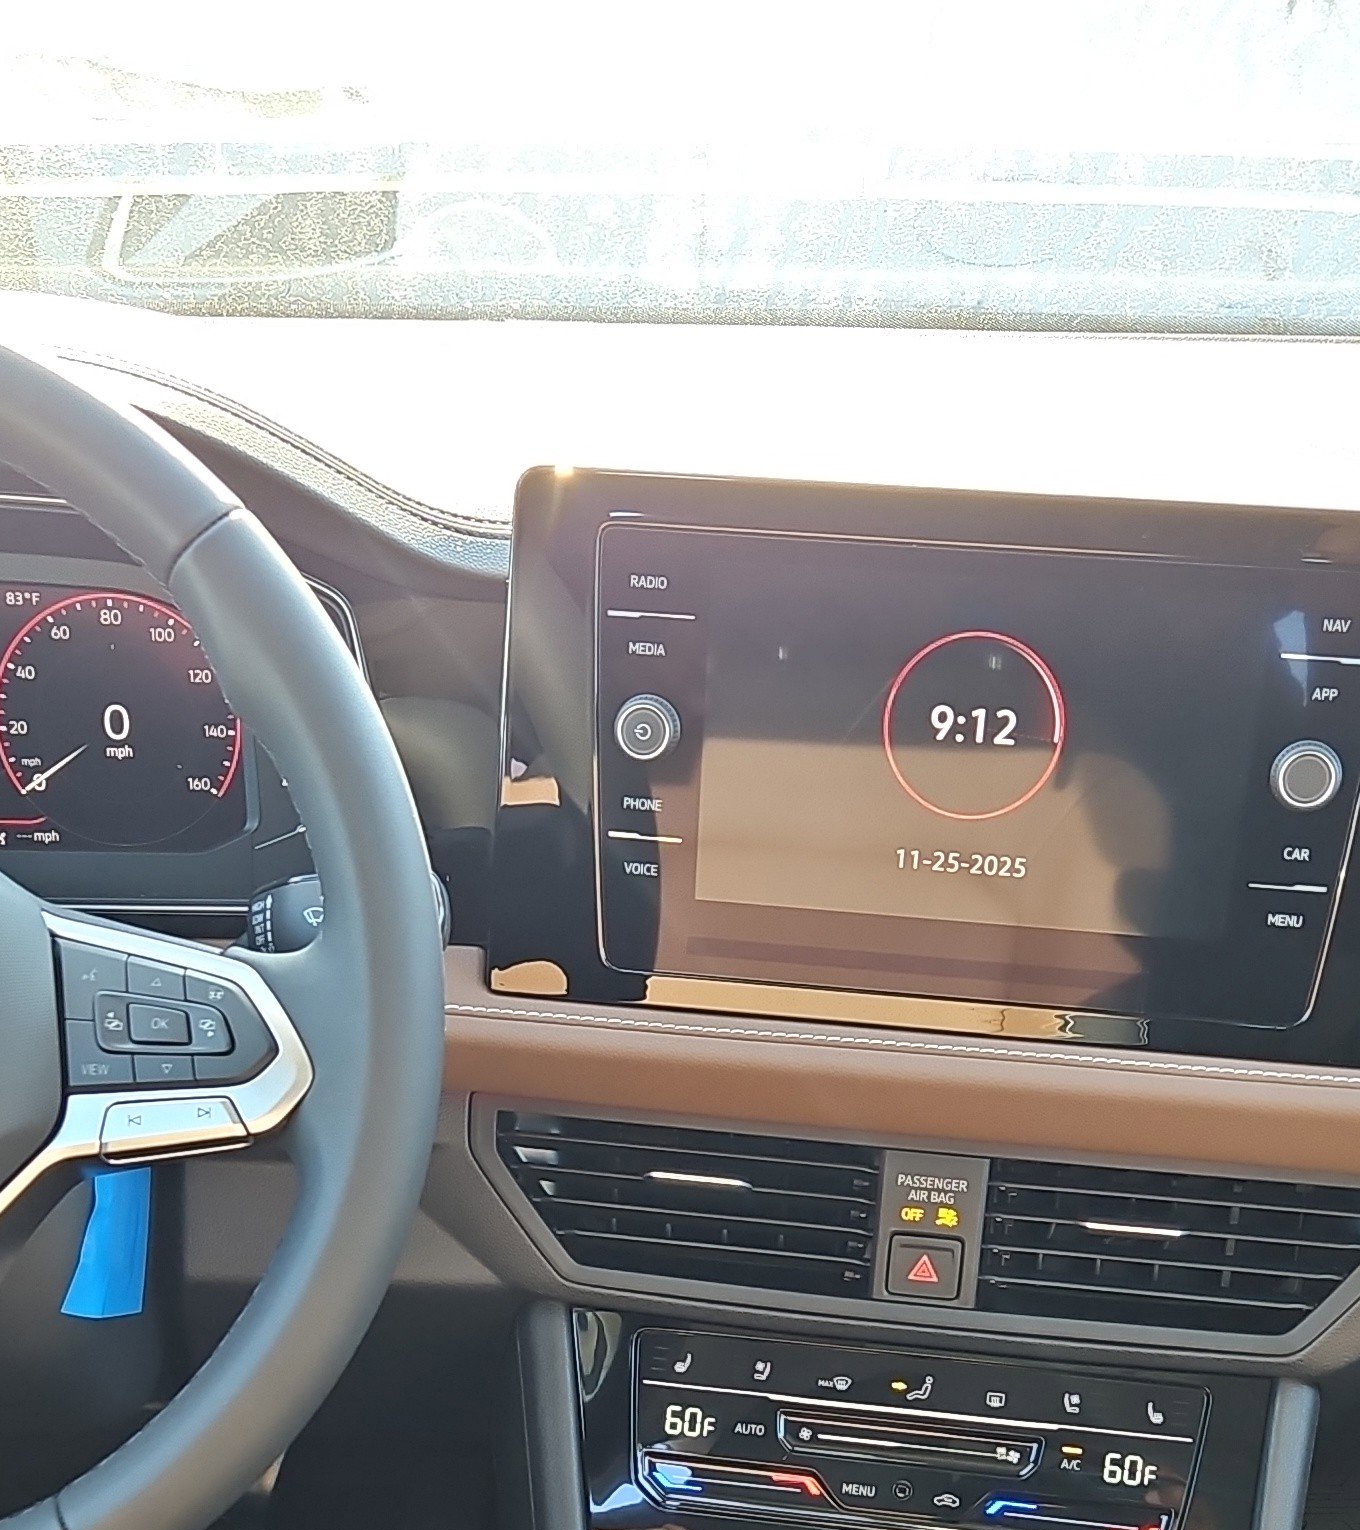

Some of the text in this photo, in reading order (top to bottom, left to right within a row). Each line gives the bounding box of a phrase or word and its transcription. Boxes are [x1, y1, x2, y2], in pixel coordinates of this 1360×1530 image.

[630, 574, 668, 589] RADIO
[5, 591, 40, 606] 83°F
[99, 609, 122, 625] 80
[50, 626, 70, 640] 60
[1323, 618, 1351, 633] NAV
[149, 627, 175, 642] 100
[628, 641, 666, 657] MEDIA
[15, 665, 36, 680] 40
[188, 669, 212, 684] 120
[1311, 687, 1339, 701] APP
[9, 720, 28, 735] 20
[103, 704, 130, 741] 0
[930, 704, 1017, 746] 9:12
[203, 725, 227, 738] 140
[106, 745, 134, 759] mph
[21, 757, 42, 768] mph
[187, 777, 211, 791] 160
[623, 796, 663, 812] PHONE
[1283, 847, 1310, 861] CAR
[623, 861, 658, 877] VOICE
[896, 848, 1027, 878] 11-25-2025
[1267, 913, 1304, 928] MENU
[150, 1017, 169, 1030] OK
[81, 1064, 110, 1075] VIEW
[897, 1174, 968, 1192] PASSENGER
[908, 1190, 955, 1205] AIR BAG
[901, 1207, 925, 1221] OFF
[734, 1422, 765, 1436] AUTO
[1060, 1458, 1082, 1471] A/C
[842, 1482, 876, 1498] MENU
